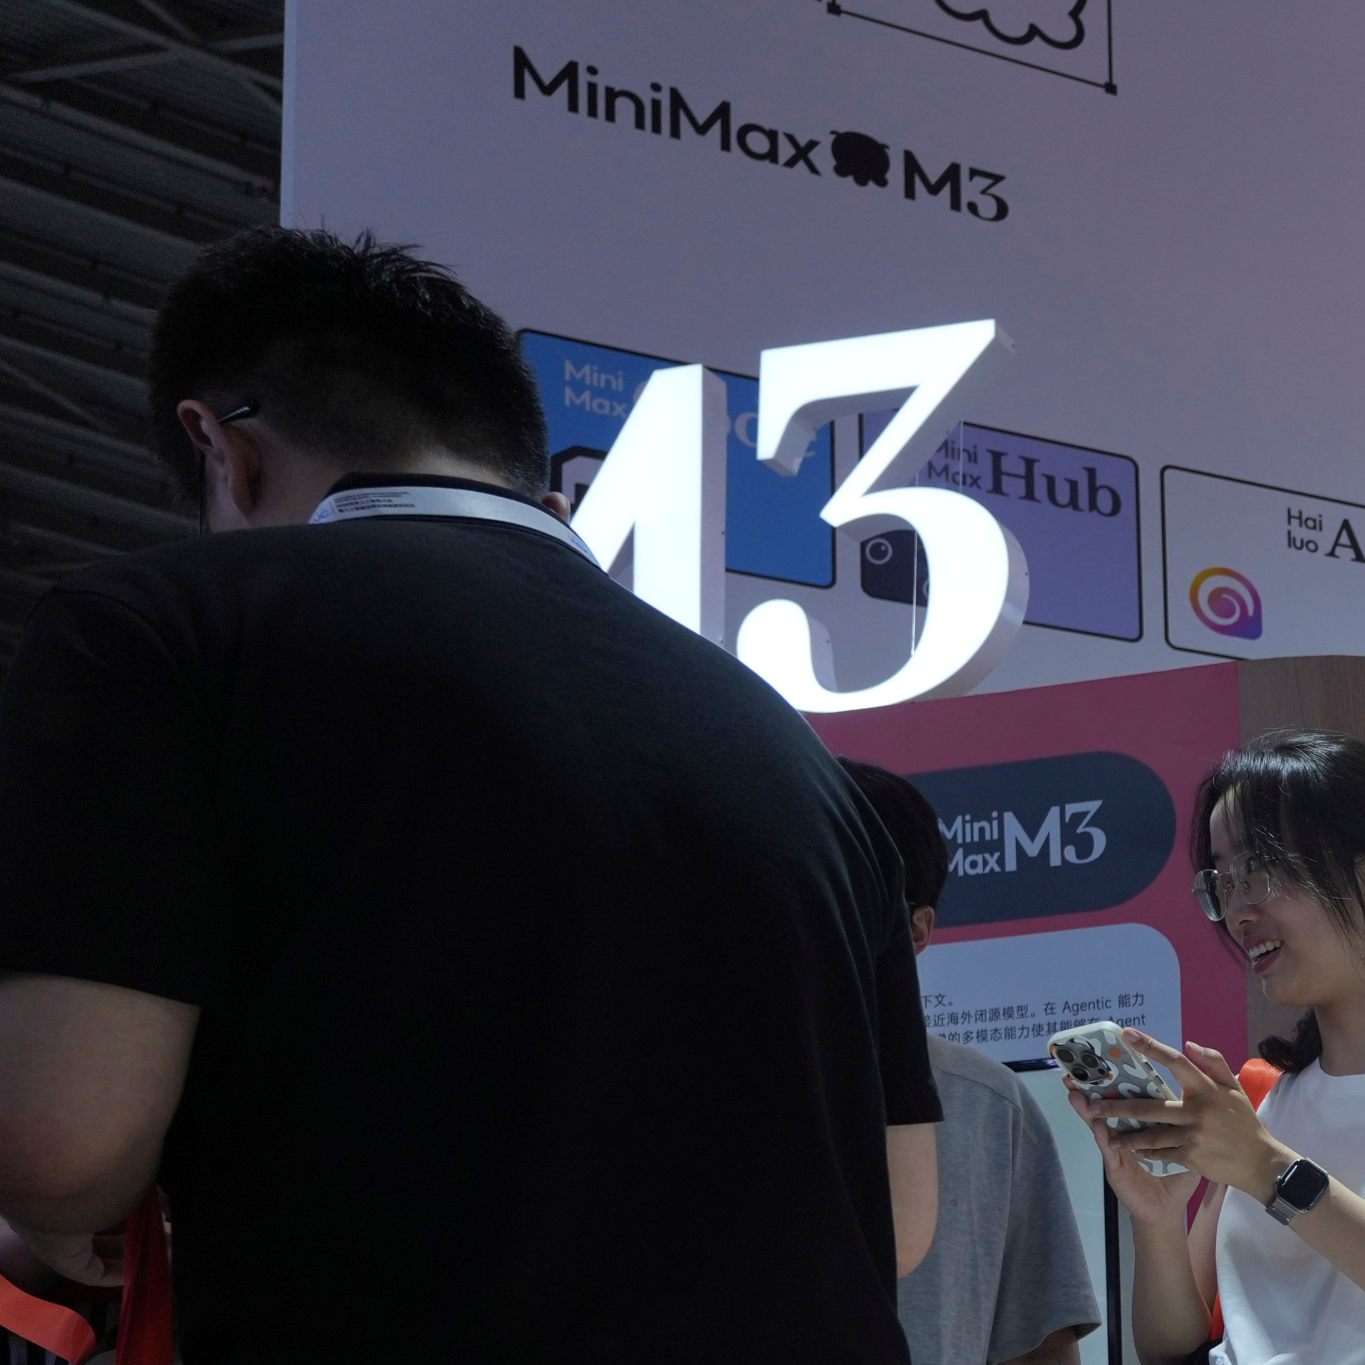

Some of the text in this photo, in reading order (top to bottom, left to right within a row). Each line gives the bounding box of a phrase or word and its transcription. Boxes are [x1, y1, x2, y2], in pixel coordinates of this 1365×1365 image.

[512, 45, 1010, 222] MiniMax M3
[564, 360, 624, 392] Mini
[564, 386, 628, 418] Max
[927, 460, 982, 489] Max
[986, 448, 1122, 518] Hub
[1286, 506, 1323, 533] Hai
[1286, 529, 1319, 555] luo
[938, 808, 999, 845] Mini
[1005, 798, 1107, 873] M3
[1063, 996, 1112, 1017] Agentic
[1118, 992, 1145, 1009] 能力
